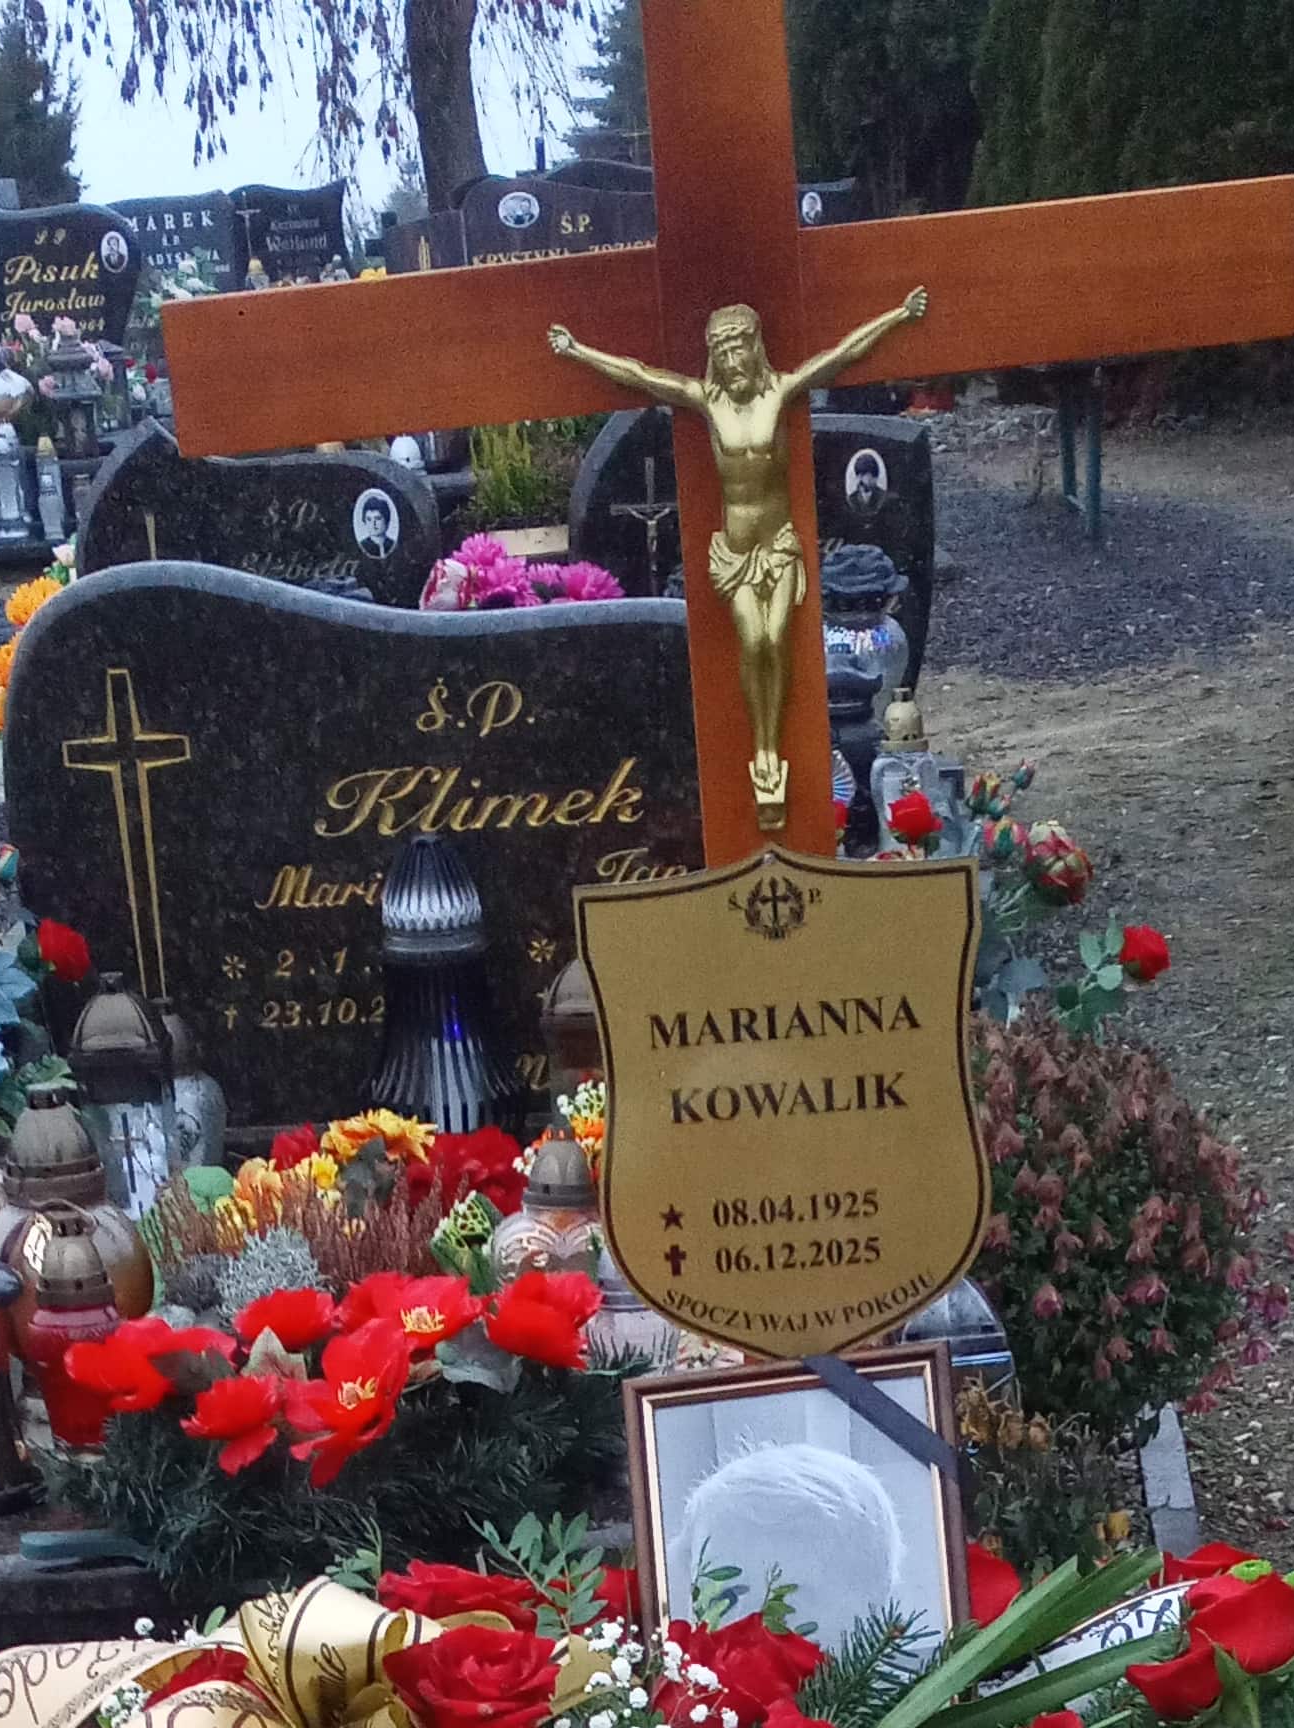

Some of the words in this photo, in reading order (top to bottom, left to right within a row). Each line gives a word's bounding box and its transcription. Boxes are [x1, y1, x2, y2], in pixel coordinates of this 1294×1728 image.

[3, 251, 100, 286] Pisuk
[315, 757, 644, 838] Klimek
[254, 862, 384, 911] Mari
[649, 994, 921, 1050] MARIANNA
[669, 1071, 907, 1124] KOWALIK
[712, 1188, 880, 1228] 08.04.1925
[714, 1236, 882, 1274] 06.12.2025
[662, 1288, 809, 1333] SPOCZYWAJ
[813, 1309, 839, 1330] W
[842, 1270, 937, 1325] POKOJU
